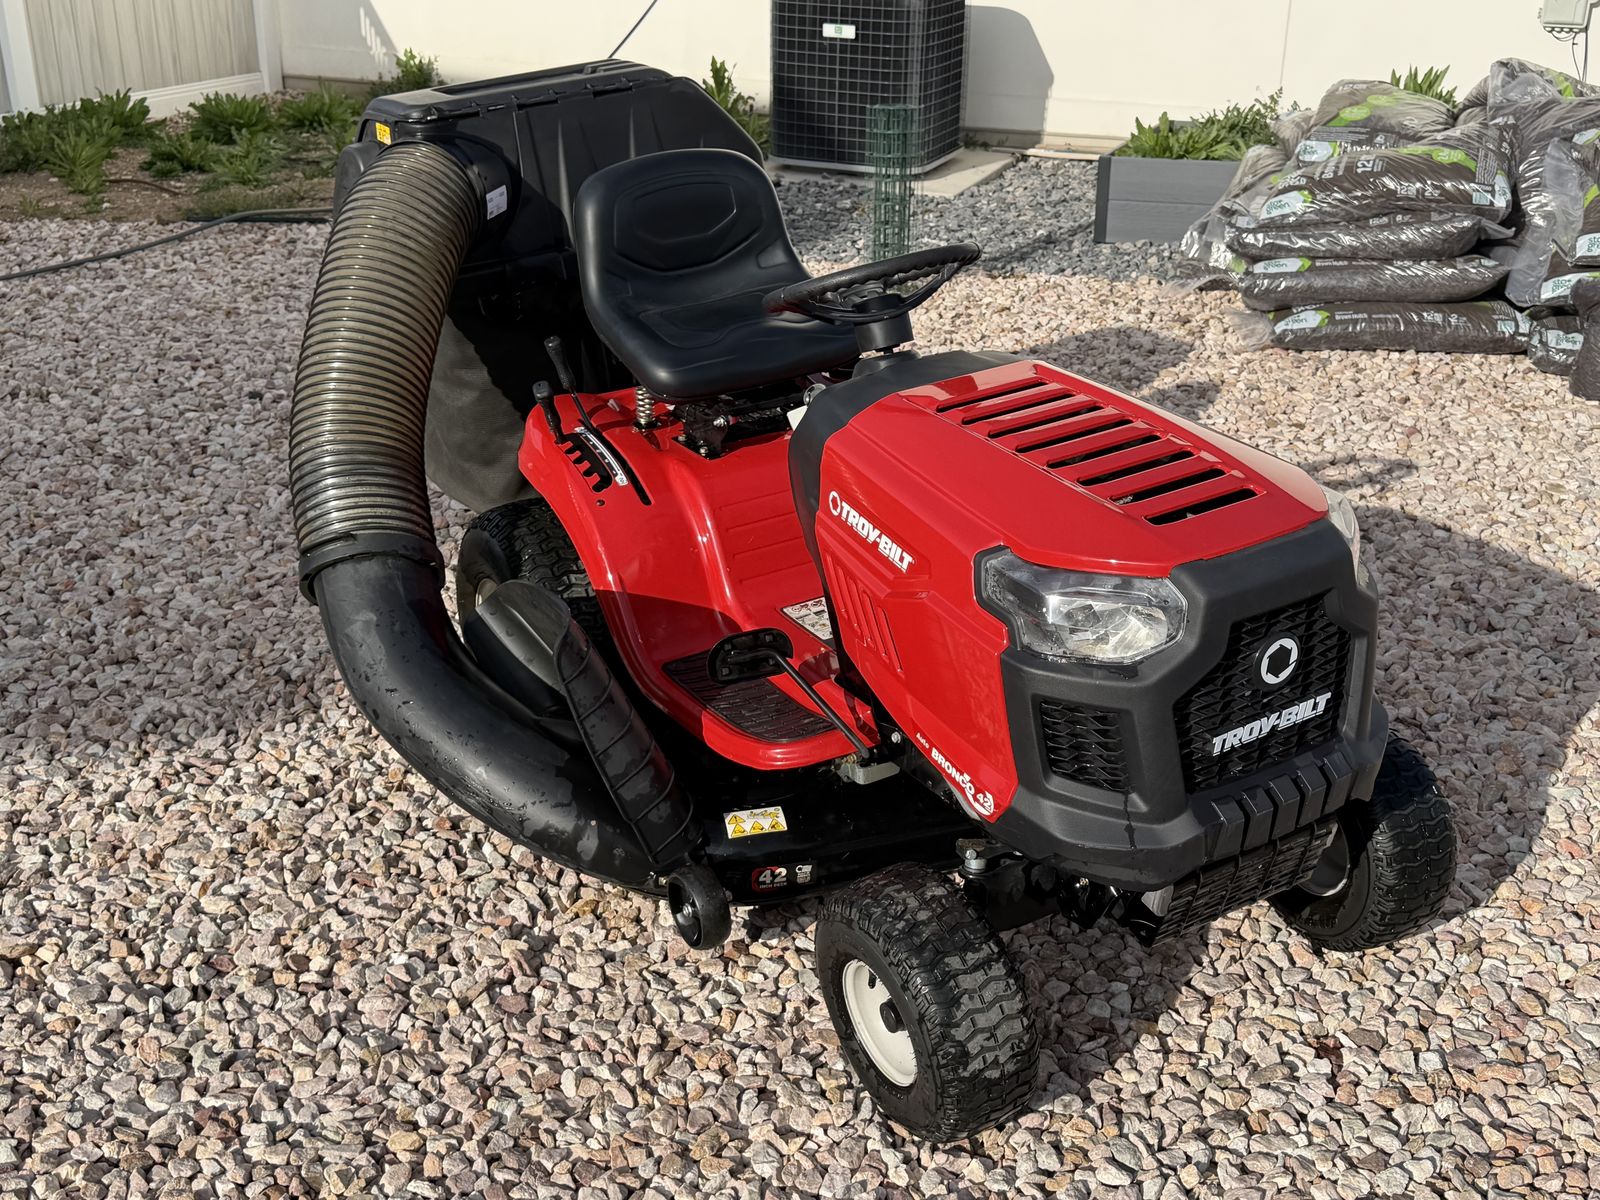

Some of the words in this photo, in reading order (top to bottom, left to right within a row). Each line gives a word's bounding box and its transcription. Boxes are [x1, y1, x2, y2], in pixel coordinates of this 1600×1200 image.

[841, 501, 913, 573] TROY-BILT
[1212, 692, 1332, 756] TROY-BILT
[931, 747, 975, 795] BRONCO
[976, 793, 992, 810] 42
[759, 867, 787, 884] 42
